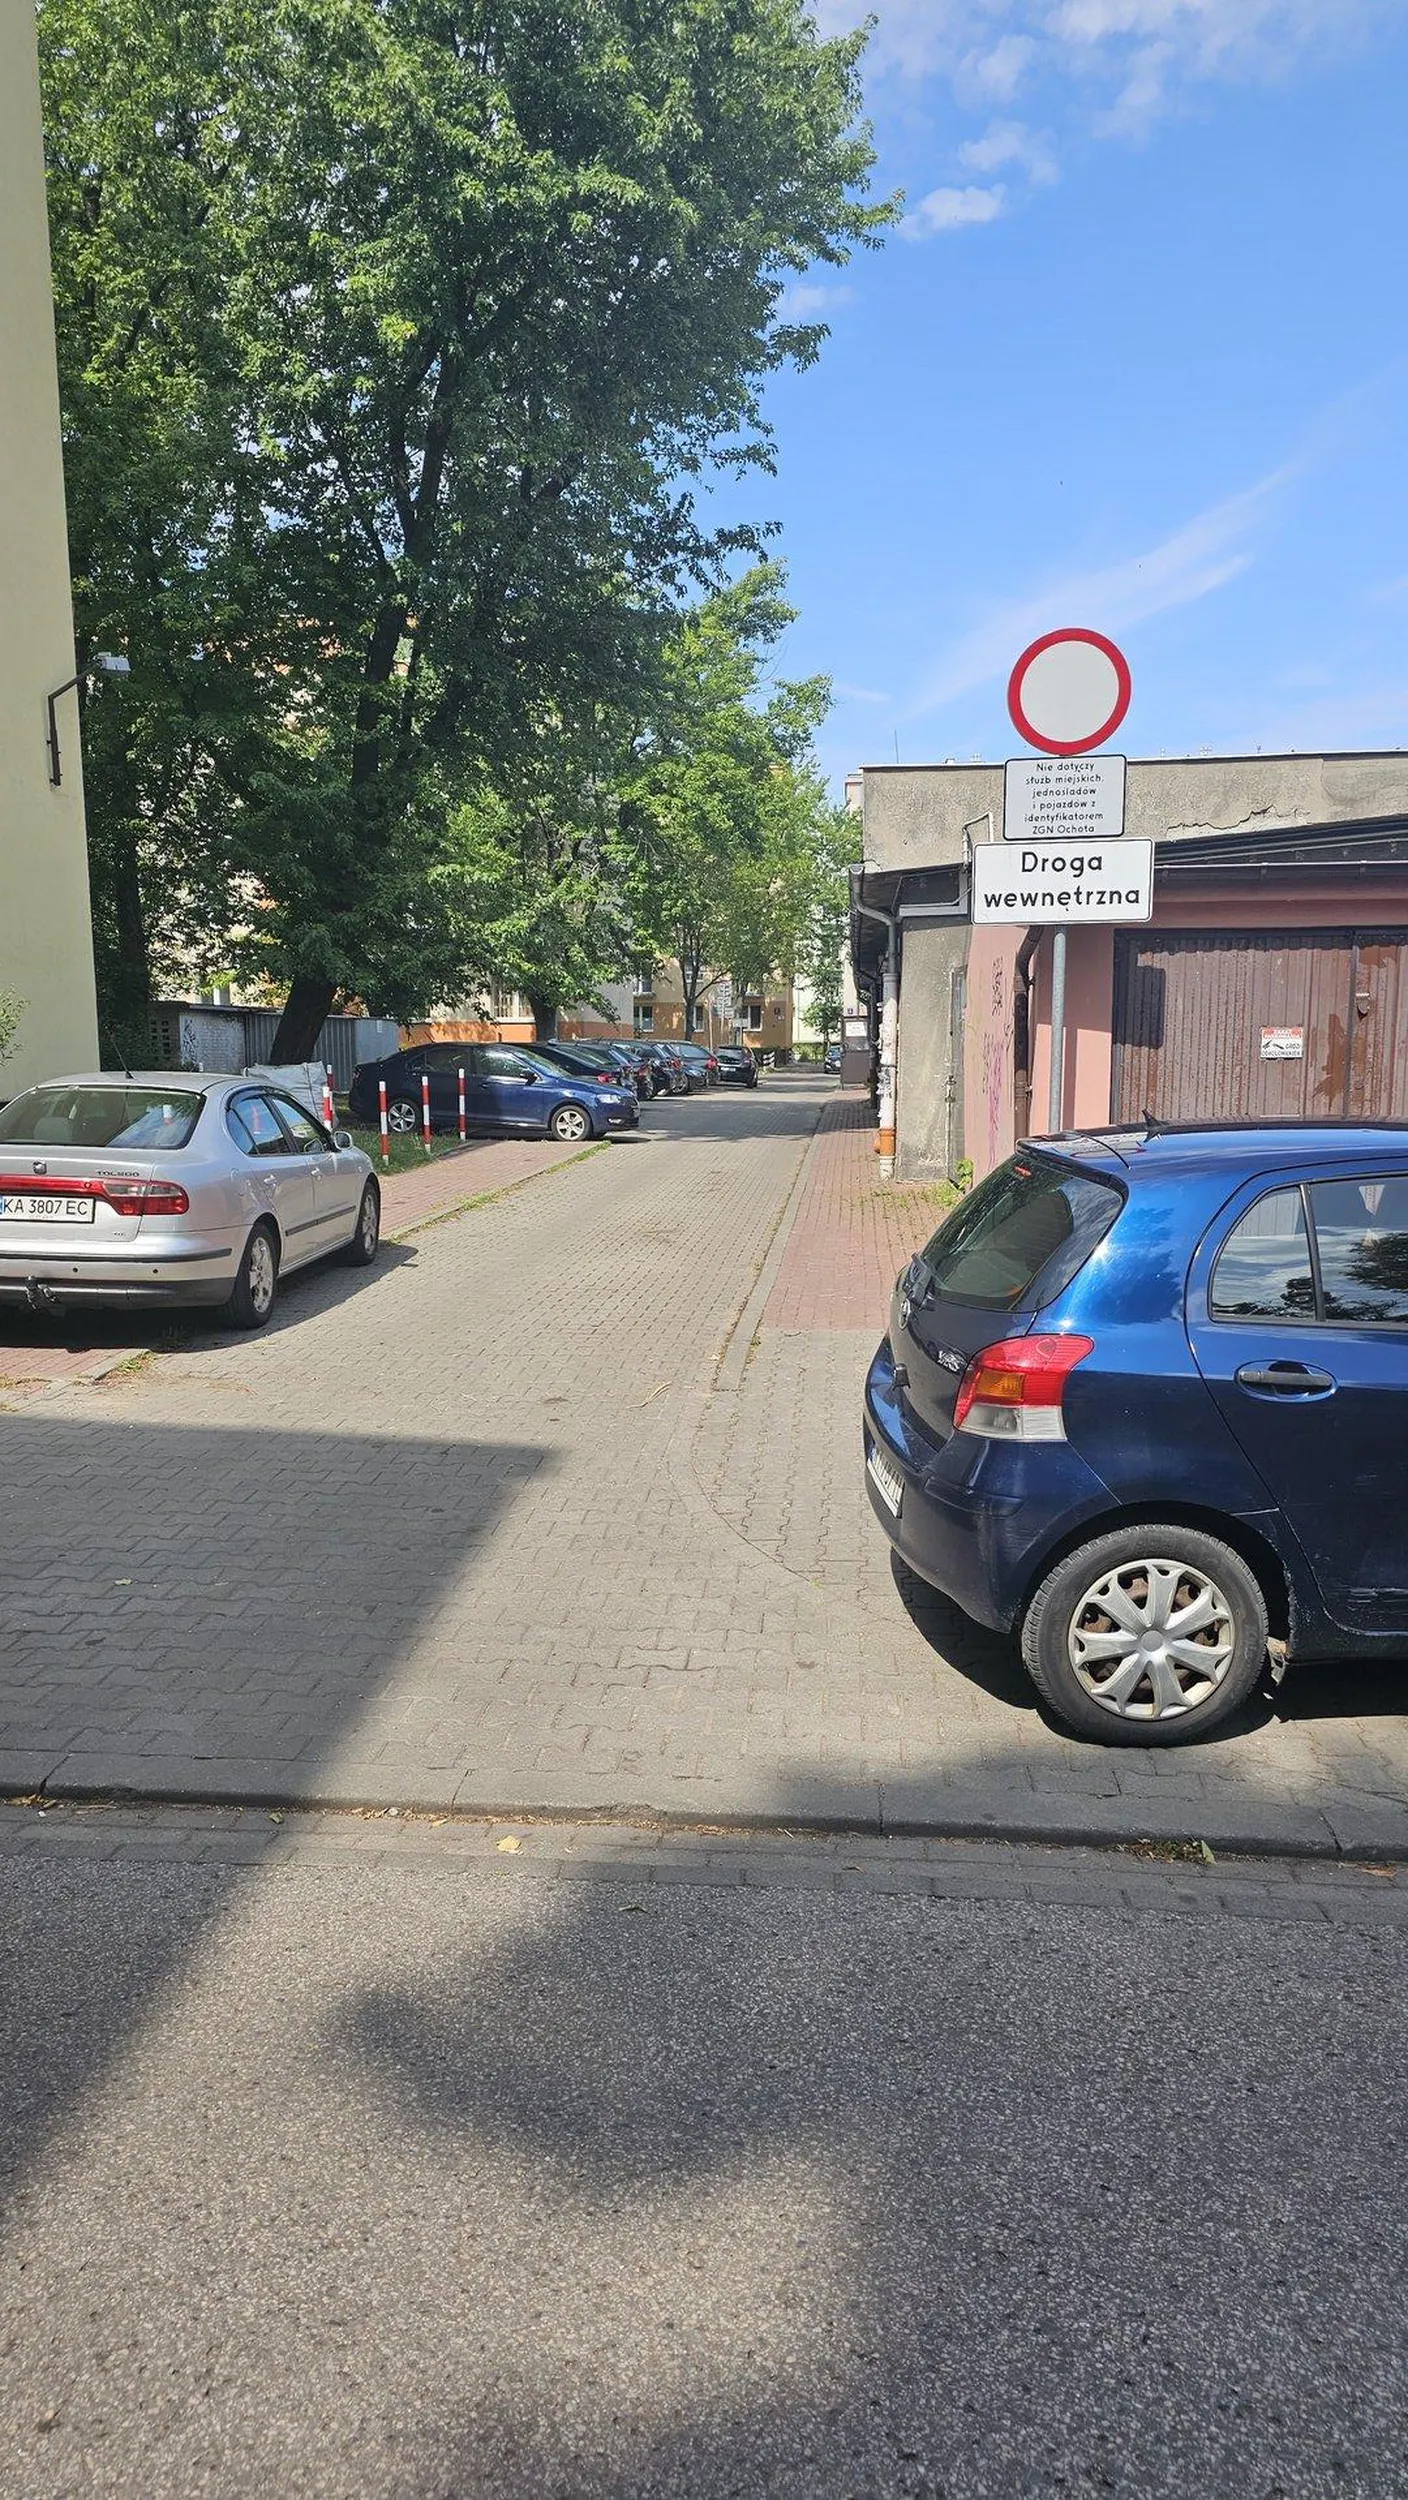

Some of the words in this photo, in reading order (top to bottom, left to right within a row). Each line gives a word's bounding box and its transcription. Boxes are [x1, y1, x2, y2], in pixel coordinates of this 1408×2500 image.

[1036, 764, 1054, 772] Nie
[1057, 763, 1095, 772] dotyczy
[1024, 812, 1104, 823] identyfikatorem
[1032, 825, 1054, 835] ZGN
[1057, 824, 1095, 834] Ochota
[1021, 851, 1103, 878] Droga
[984, 885, 1140, 912] wewnętrzna
[3, 1198, 24, 1213] KA
[28, 1199, 63, 1214] 3807
[66, 1200, 88, 1215] EC
